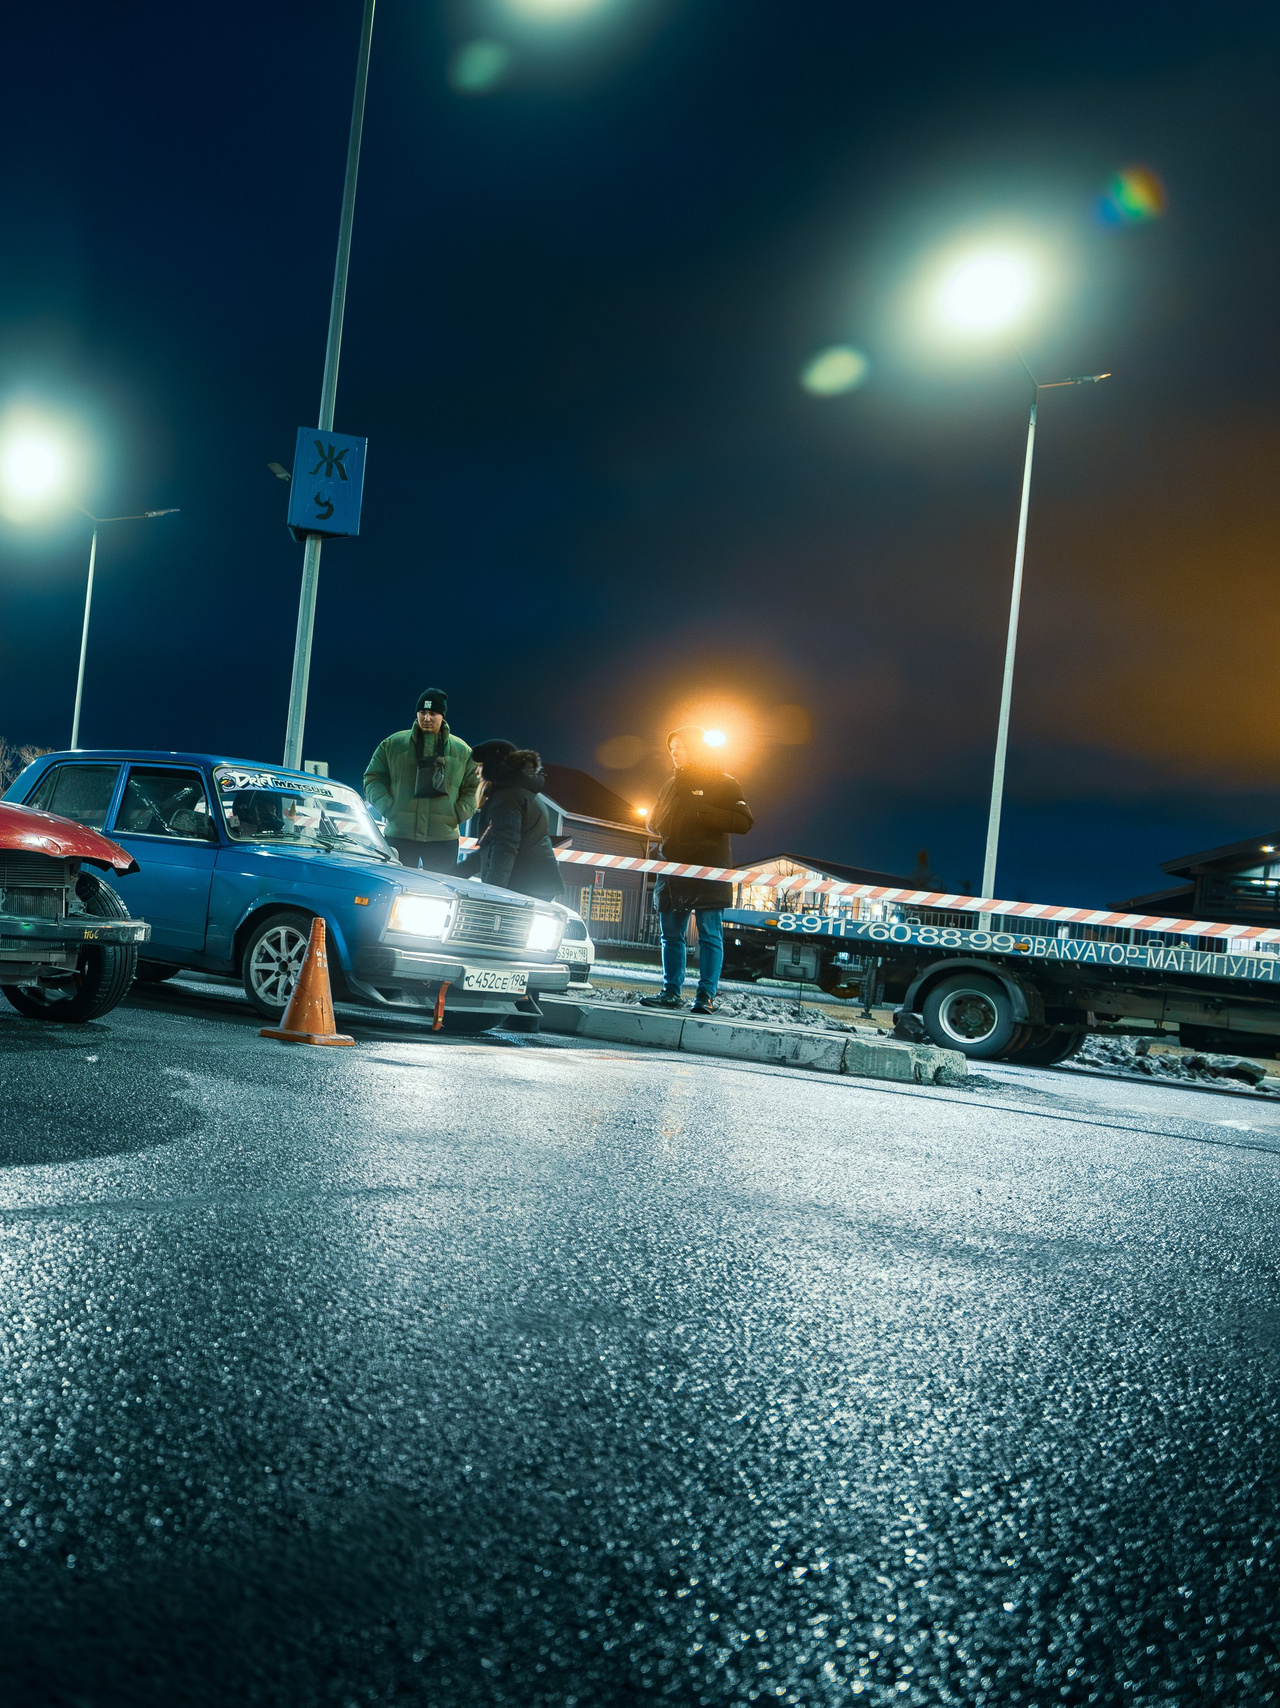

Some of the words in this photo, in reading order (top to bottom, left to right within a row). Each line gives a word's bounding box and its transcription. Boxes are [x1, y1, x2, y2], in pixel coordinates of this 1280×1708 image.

[273, 779, 334, 798] MATSURI
[777, 913, 1017, 953] 8-911-760-88-99
[1020, 937, 1280, 981] ЭВАКУАТОР-МАНИПУЛЯ
[510, 974, 526, 987] 198
